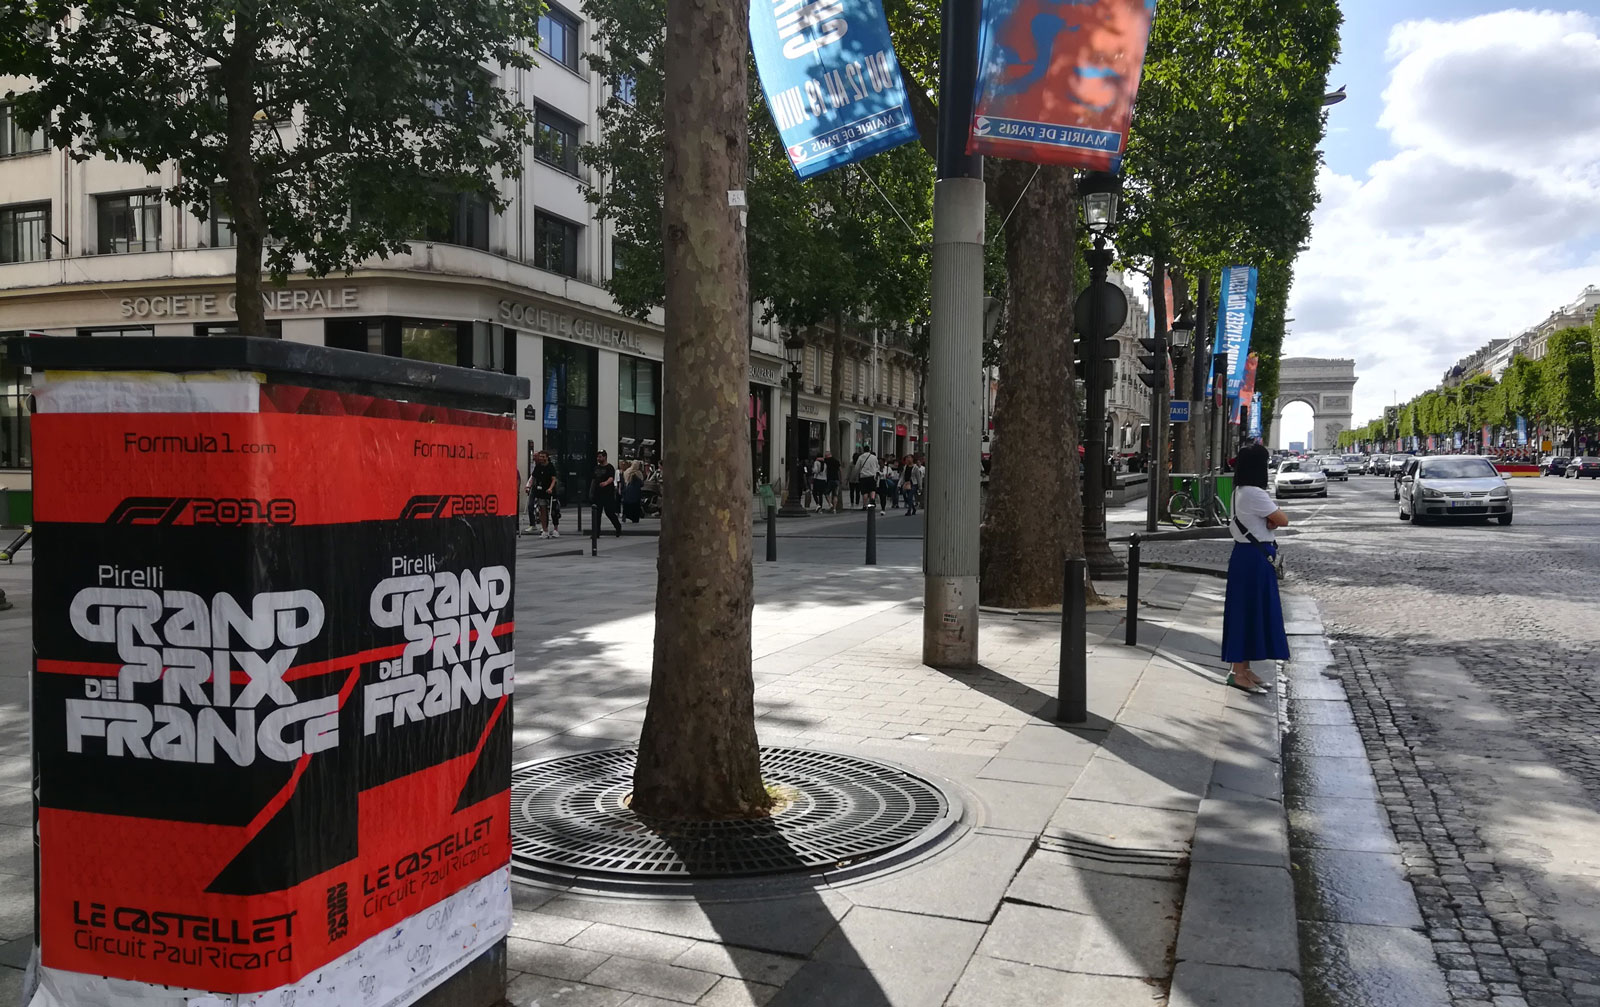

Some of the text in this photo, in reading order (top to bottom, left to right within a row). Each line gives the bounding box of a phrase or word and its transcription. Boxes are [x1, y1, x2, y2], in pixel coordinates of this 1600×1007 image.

[120, 288, 358, 317] SOCIETE GNERALE
[500, 300, 640, 349] SOCIETE GENERALE
[1170, 407, 1188, 415] TAXIS
[193, 498, 296, 526] 2018
[451, 494, 498, 515] 2018
[98, 564, 164, 588] Pirelli
[391, 553, 436, 576] Pirelli
[403, 610, 500, 675] PRIX
[116, 645, 298, 708] PRIX
[379, 658, 402, 680] DE
[85, 678, 117, 700] DE
[66, 694, 339, 767] FRANCE
[364, 865, 389, 896] LE
[363, 877, 416, 918] Circuit
[73, 901, 106, 928] LE
[74, 929, 146, 959] Circuit
